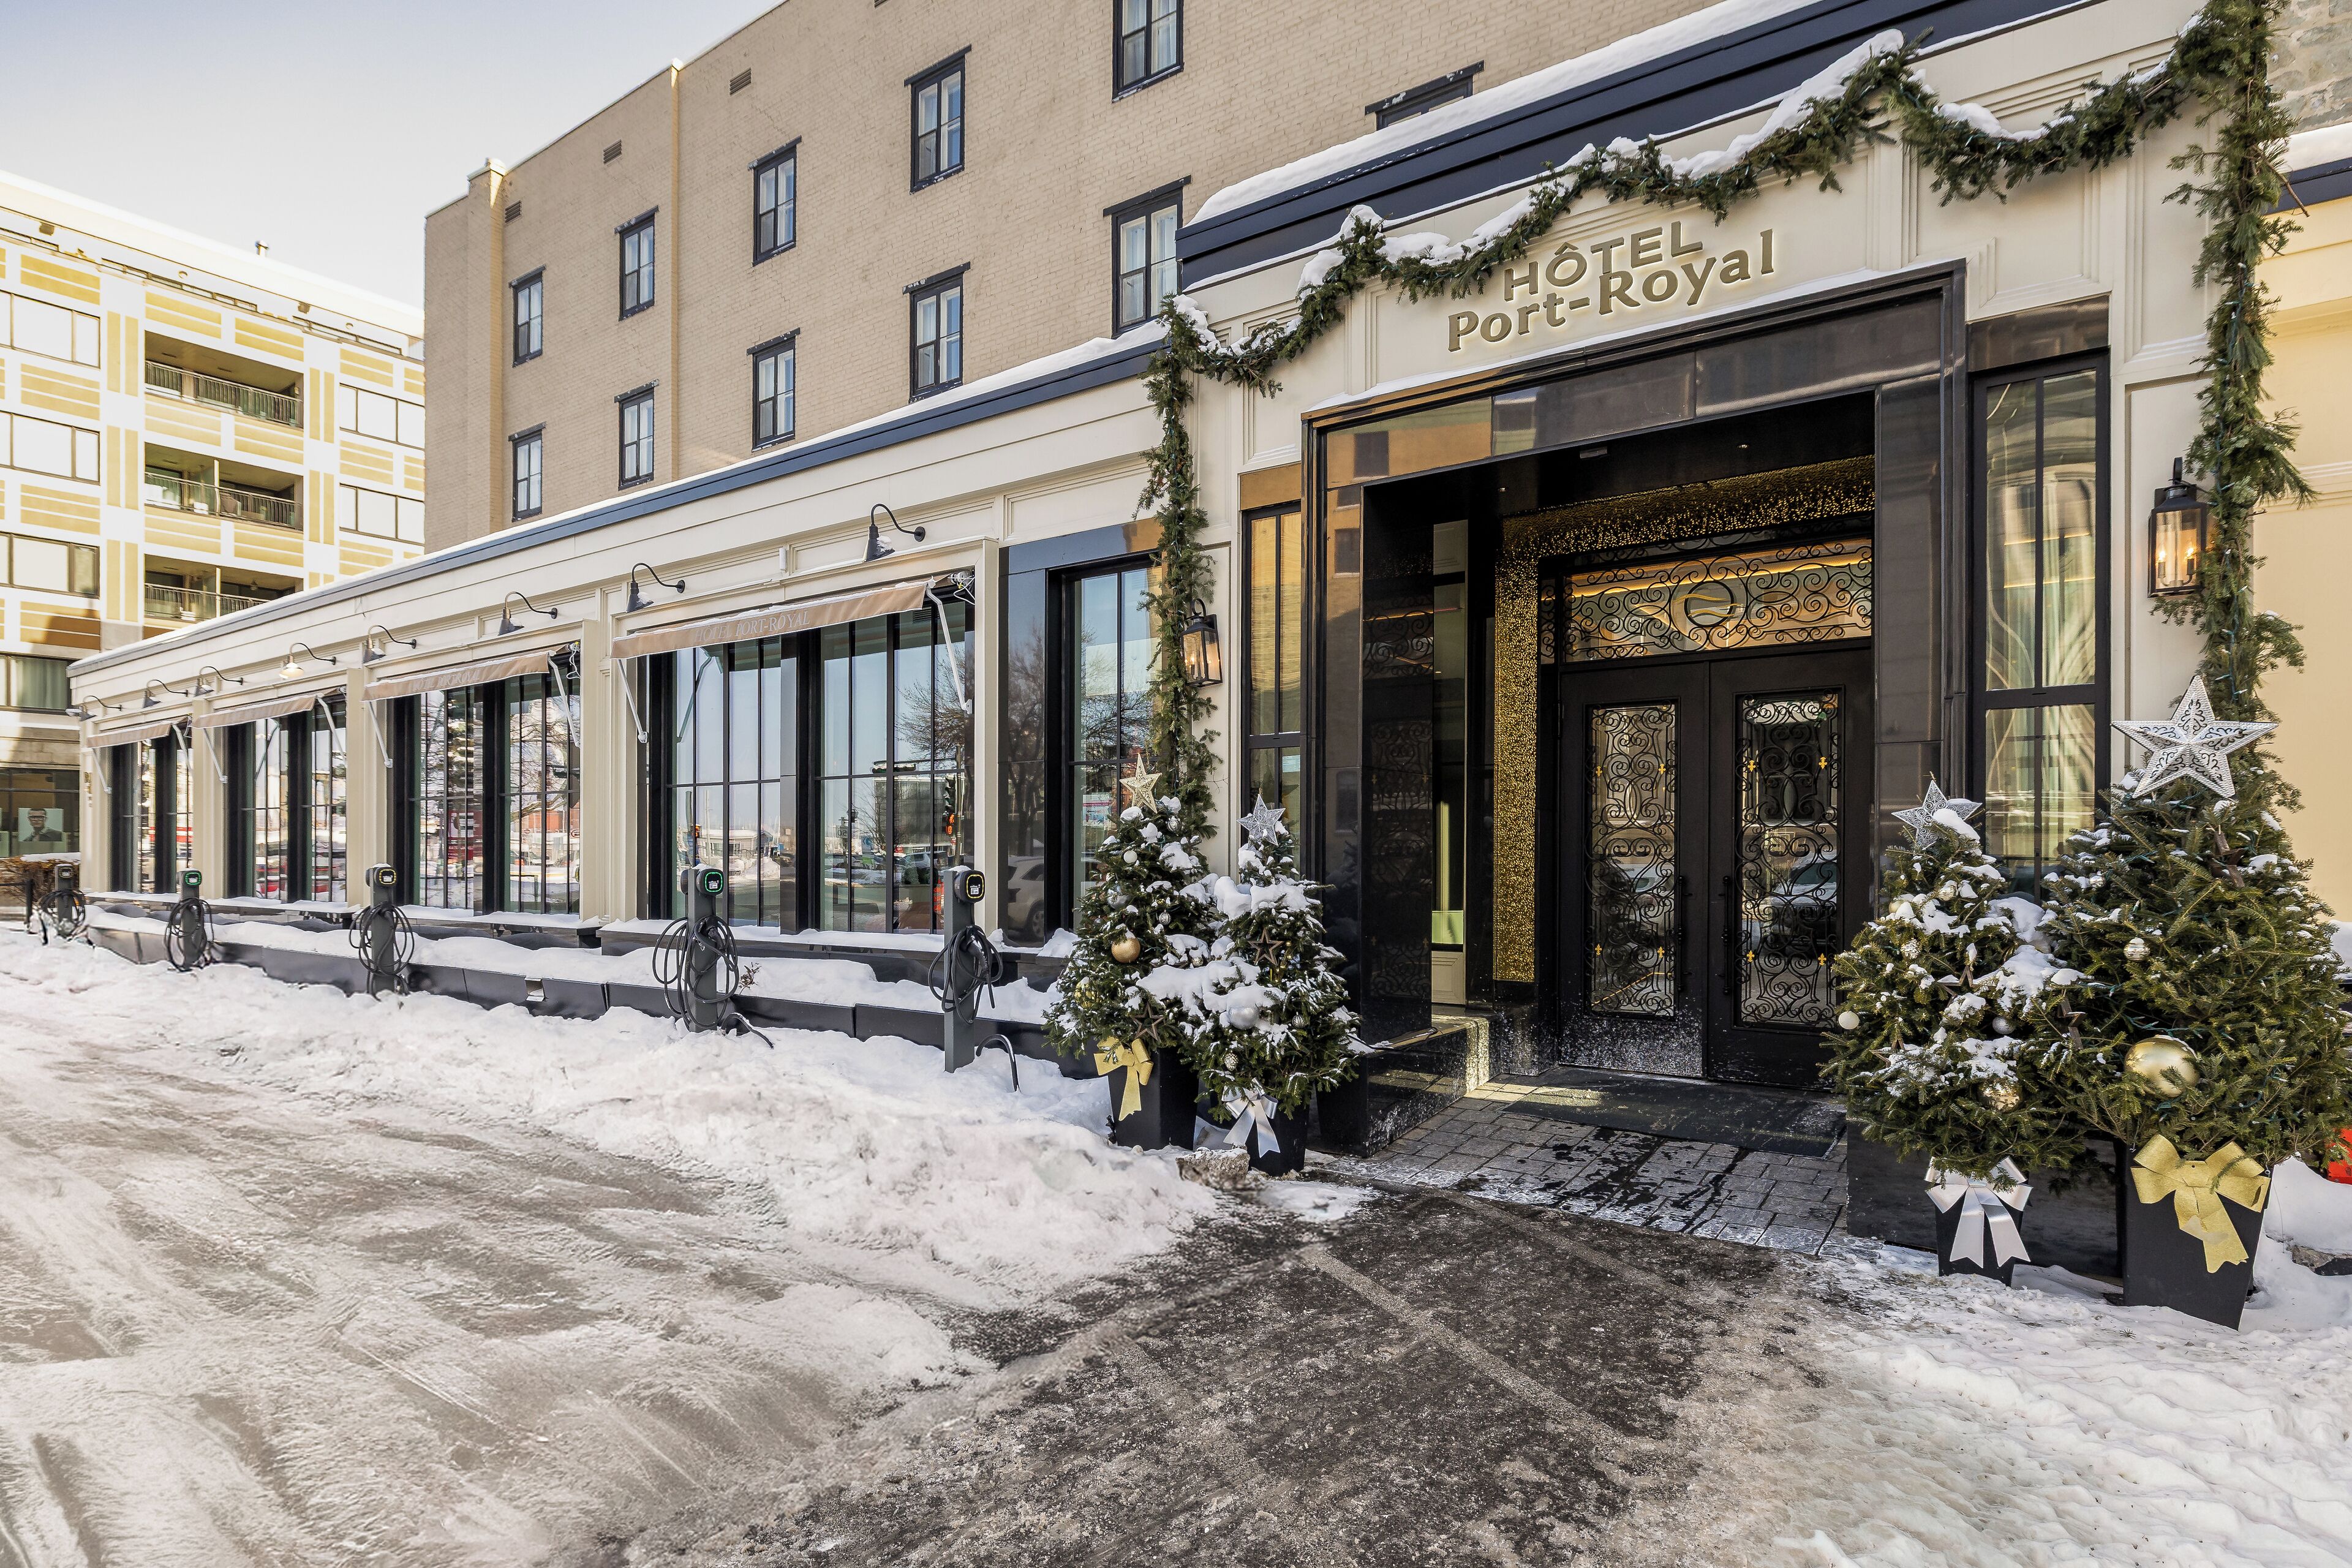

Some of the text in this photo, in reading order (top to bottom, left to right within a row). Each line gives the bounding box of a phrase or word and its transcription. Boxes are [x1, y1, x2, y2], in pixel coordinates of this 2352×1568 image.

[1448, 228, 1774, 353] Port-Royal
[1503, 221, 1703, 301] HÔTEL
[695, 611, 811, 642] HÔTEL PORT-ROYAL
